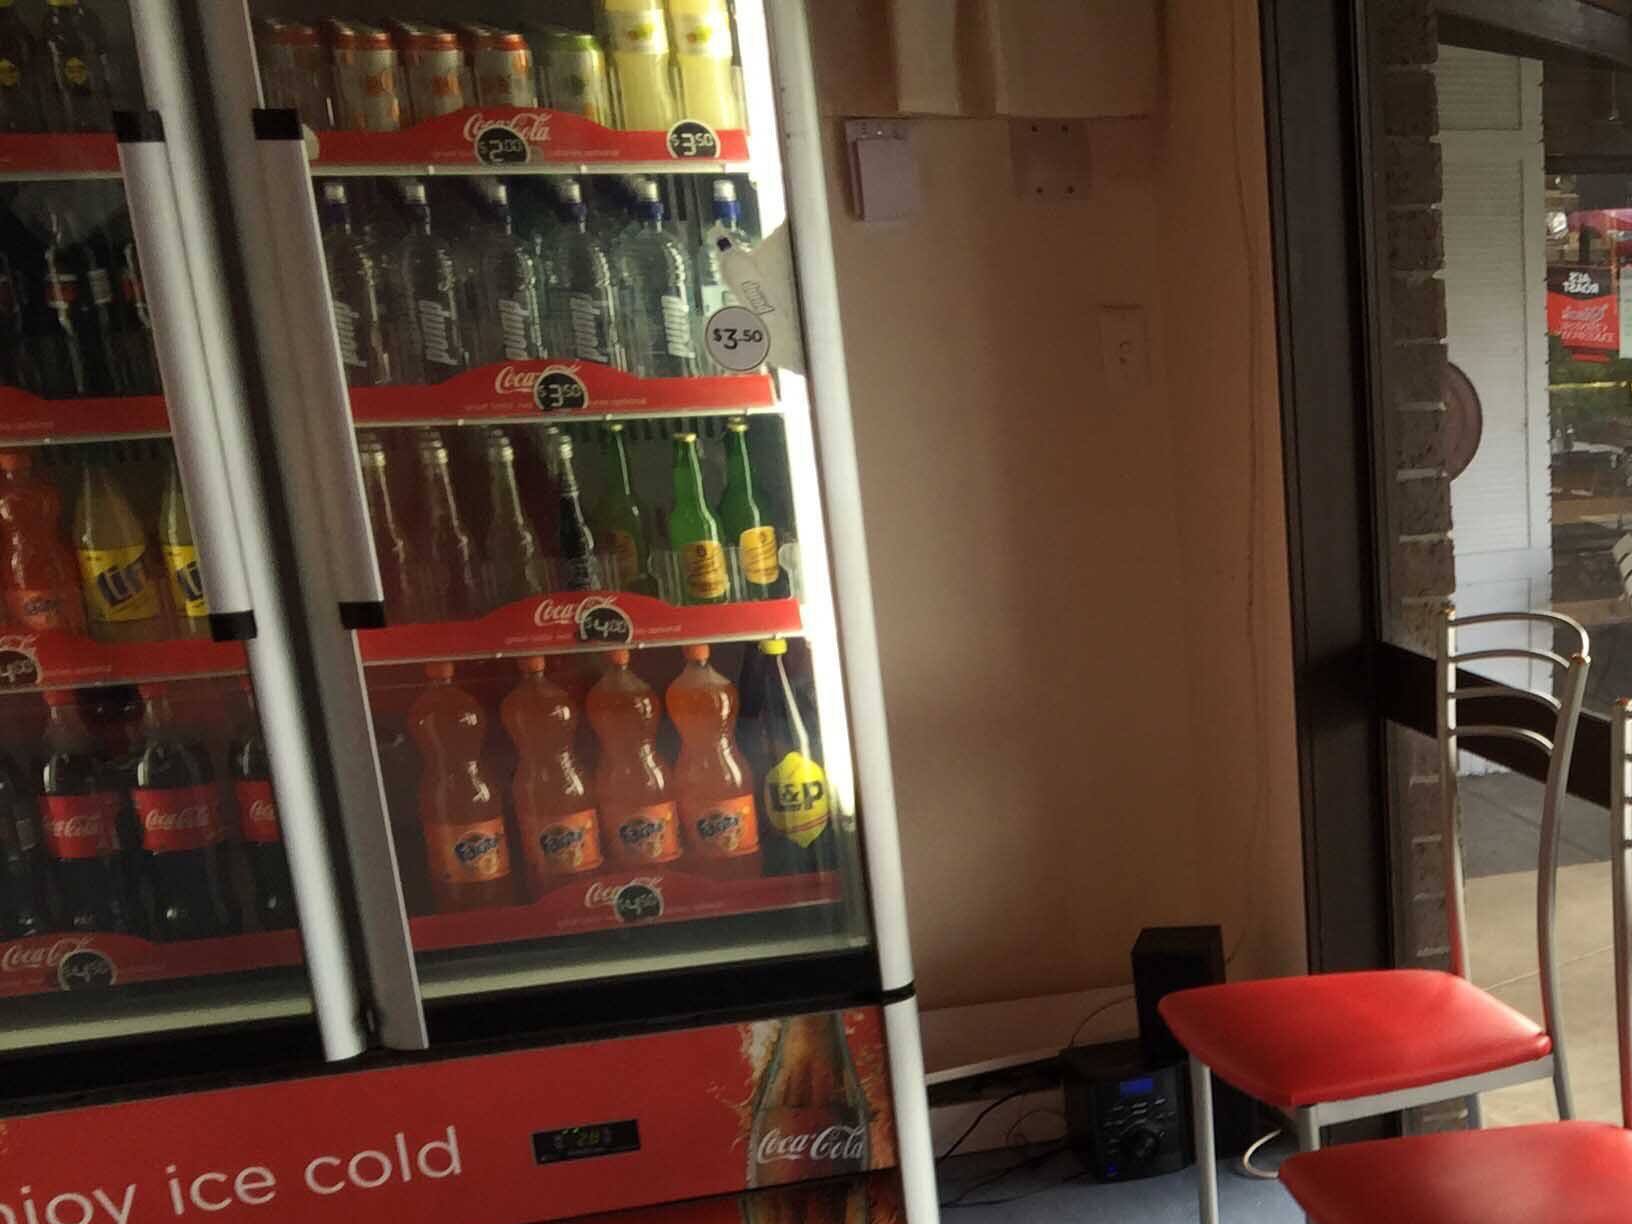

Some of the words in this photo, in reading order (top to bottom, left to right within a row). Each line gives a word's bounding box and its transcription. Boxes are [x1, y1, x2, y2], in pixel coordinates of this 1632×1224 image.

[769, 780, 824, 812] L&P
[165, 1164, 277, 1216] ice
[304, 1125, 462, 1195] cold
